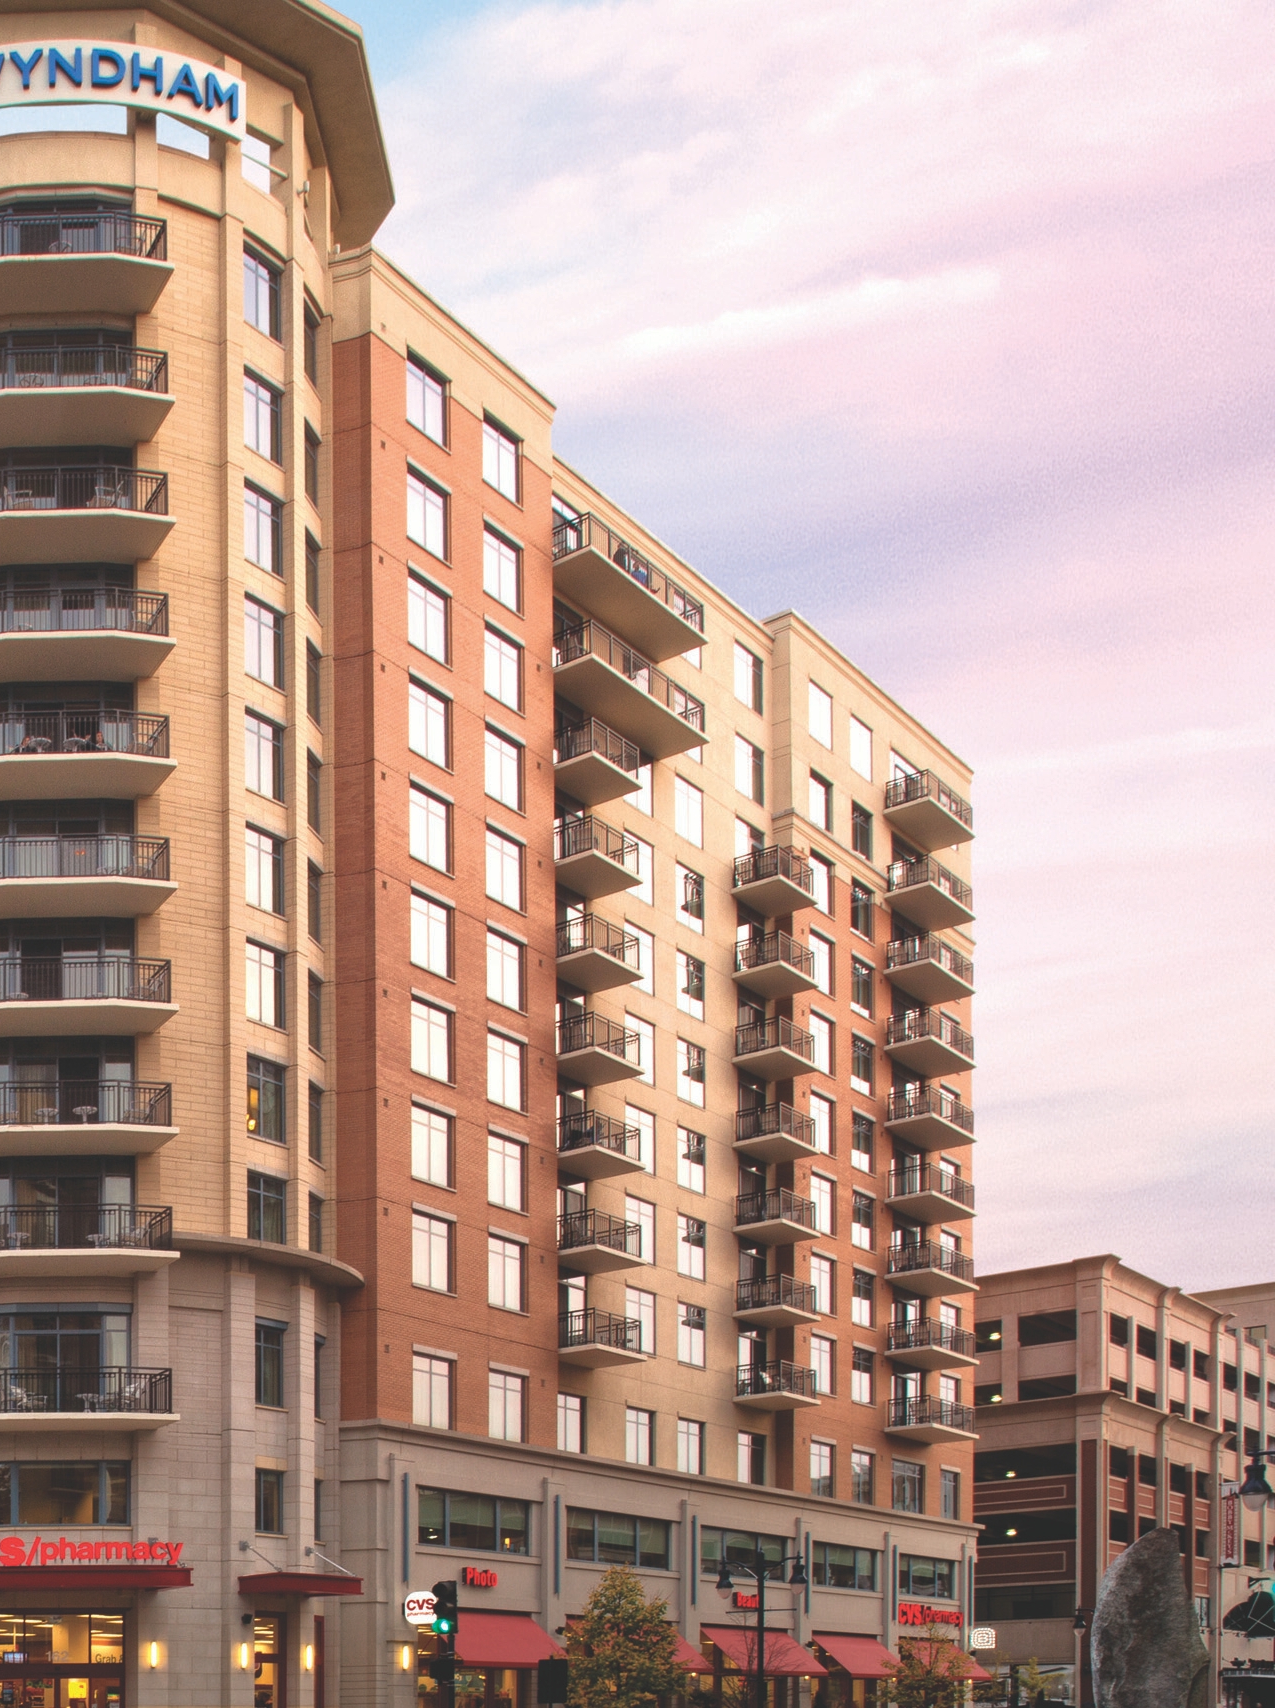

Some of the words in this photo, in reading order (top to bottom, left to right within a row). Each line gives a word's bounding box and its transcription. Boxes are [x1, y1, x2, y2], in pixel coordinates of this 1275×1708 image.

[466, 1566, 498, 1587] Photo
[406, 1598, 435, 1611] CVS
[737, 1591, 759, 1608] Beaut
[898, 1602, 963, 1628] CVS/pharmacy
[45, 1650, 69, 1662] 162
[95, 1653, 116, 1664] Grab
